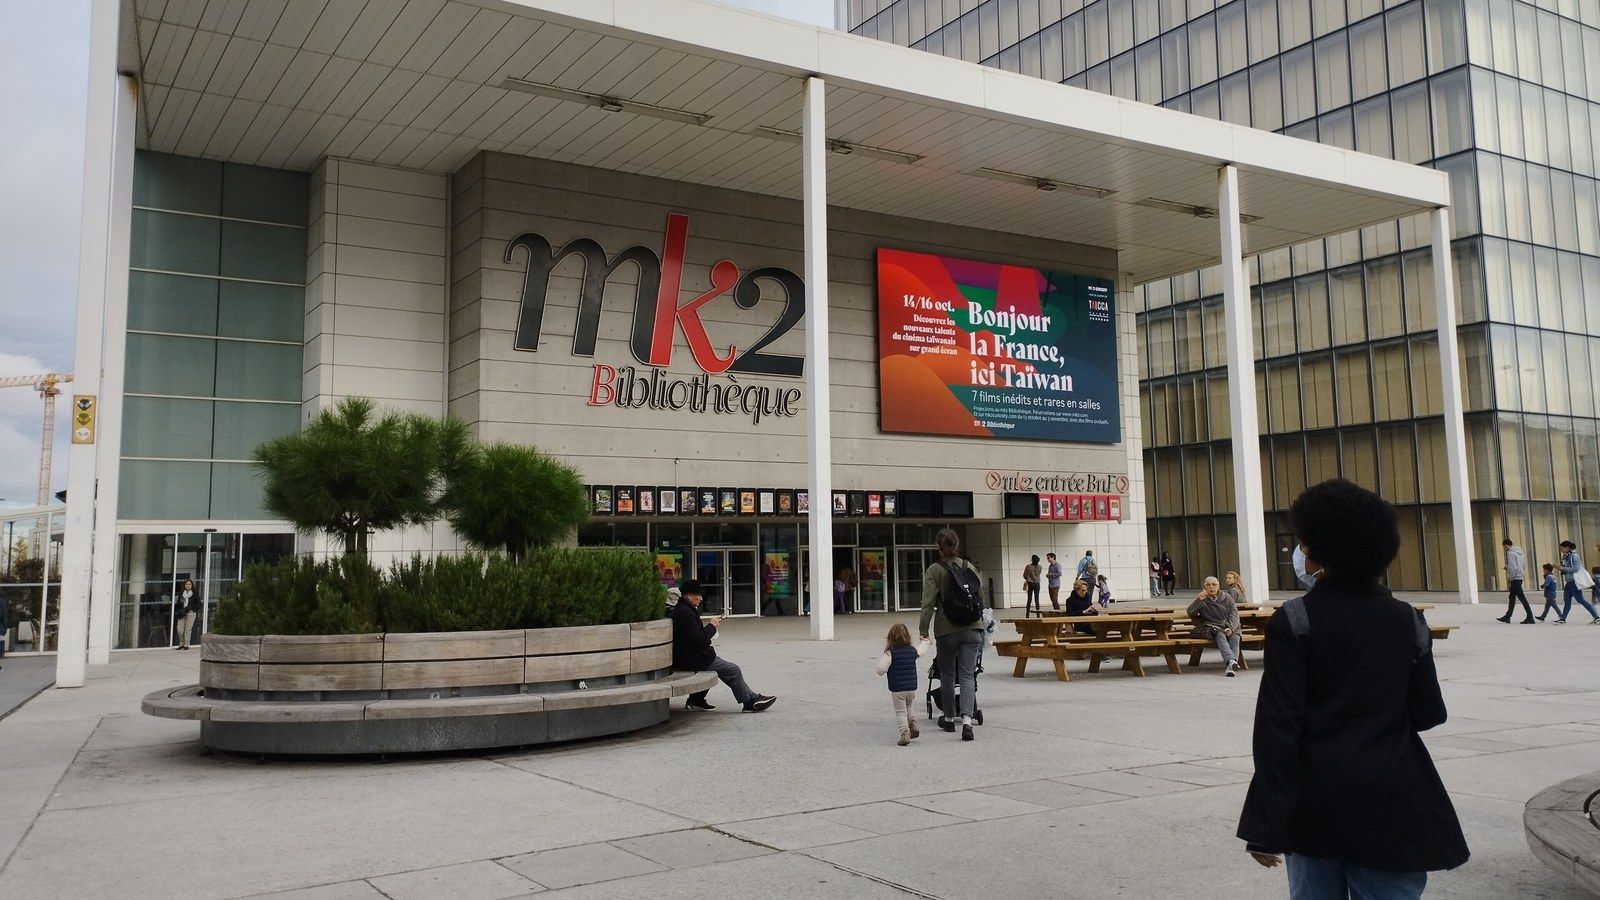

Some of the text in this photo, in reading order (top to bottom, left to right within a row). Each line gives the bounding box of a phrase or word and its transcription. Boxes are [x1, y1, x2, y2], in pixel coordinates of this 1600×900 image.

[504, 212, 805, 378] mk2
[903, 294, 955, 312] 14/16 oct.
[913, 313, 956, 326] Découvrez les
[968, 301, 1051, 336] Bonjour
[892, 332, 956, 345] du cinéma taïwanais
[903, 325, 956, 336] nouveaux talents
[921, 345, 940, 354] grand
[940, 346, 958, 355] écran
[969, 331, 1065, 369] la France,
[971, 360, 1073, 392] ici Taïwan
[587, 363, 802, 425] Bibliothèque
[972, 389, 1101, 410] 7 films inédits et rares en salles
[1002, 471, 1117, 493] mk2 entrée BnF
